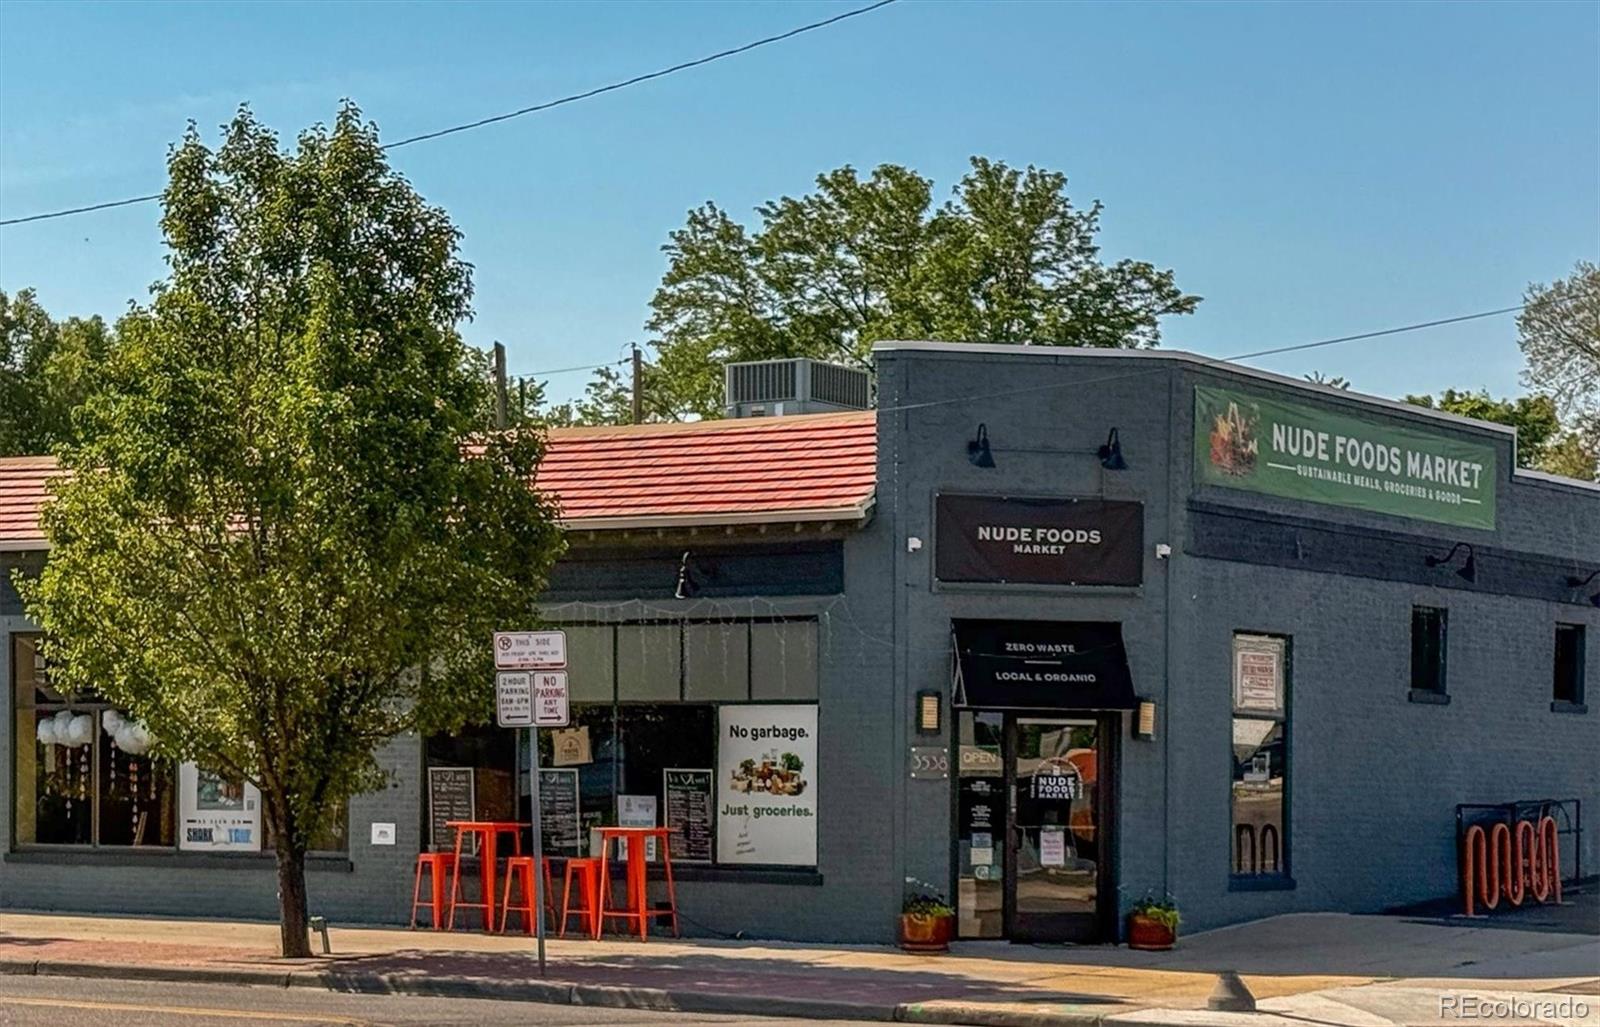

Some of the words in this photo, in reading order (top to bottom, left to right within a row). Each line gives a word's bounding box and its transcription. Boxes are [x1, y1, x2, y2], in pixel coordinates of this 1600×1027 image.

[1272, 422, 1329, 461] NUDE
[1335, 436, 1401, 476] FOODS
[1407, 451, 1483, 489] MARKET
[1296, 463, 1352, 485] SUSTAINABLE
[1353, 474, 1383, 492] MEALS,
[1383, 480, 1427, 498] GROCERIES
[1428, 489, 1434, 500] &
[1435, 490, 1461, 505] GOODS
[977, 526, 1031, 541] NUDE
[1036, 528, 1102, 544] FOODS
[1013, 544, 1066, 555] MARKET
[1005, 642, 1035, 652] ZERO
[1036, 644, 1076, 653] WASTE
[543, 675, 557, 687] NO
[995, 671, 1033, 681] LOCAL
[1034, 673, 1043, 682] &
[1043, 673, 1097, 682] ORGANIC
[500, 687, 529, 695] PARKING
[535, 687, 565, 698] PARKING
[543, 706, 558, 714] TIME
[729, 724, 748, 738] No
[750, 724, 809, 741] garbage.
[963, 752, 996, 764] OPEN
[1039, 776, 1076, 786] NUDE
[1039, 785, 1076, 793] FOODS
[722, 804, 750, 816] Just
[753, 804, 814, 819] groceries.
